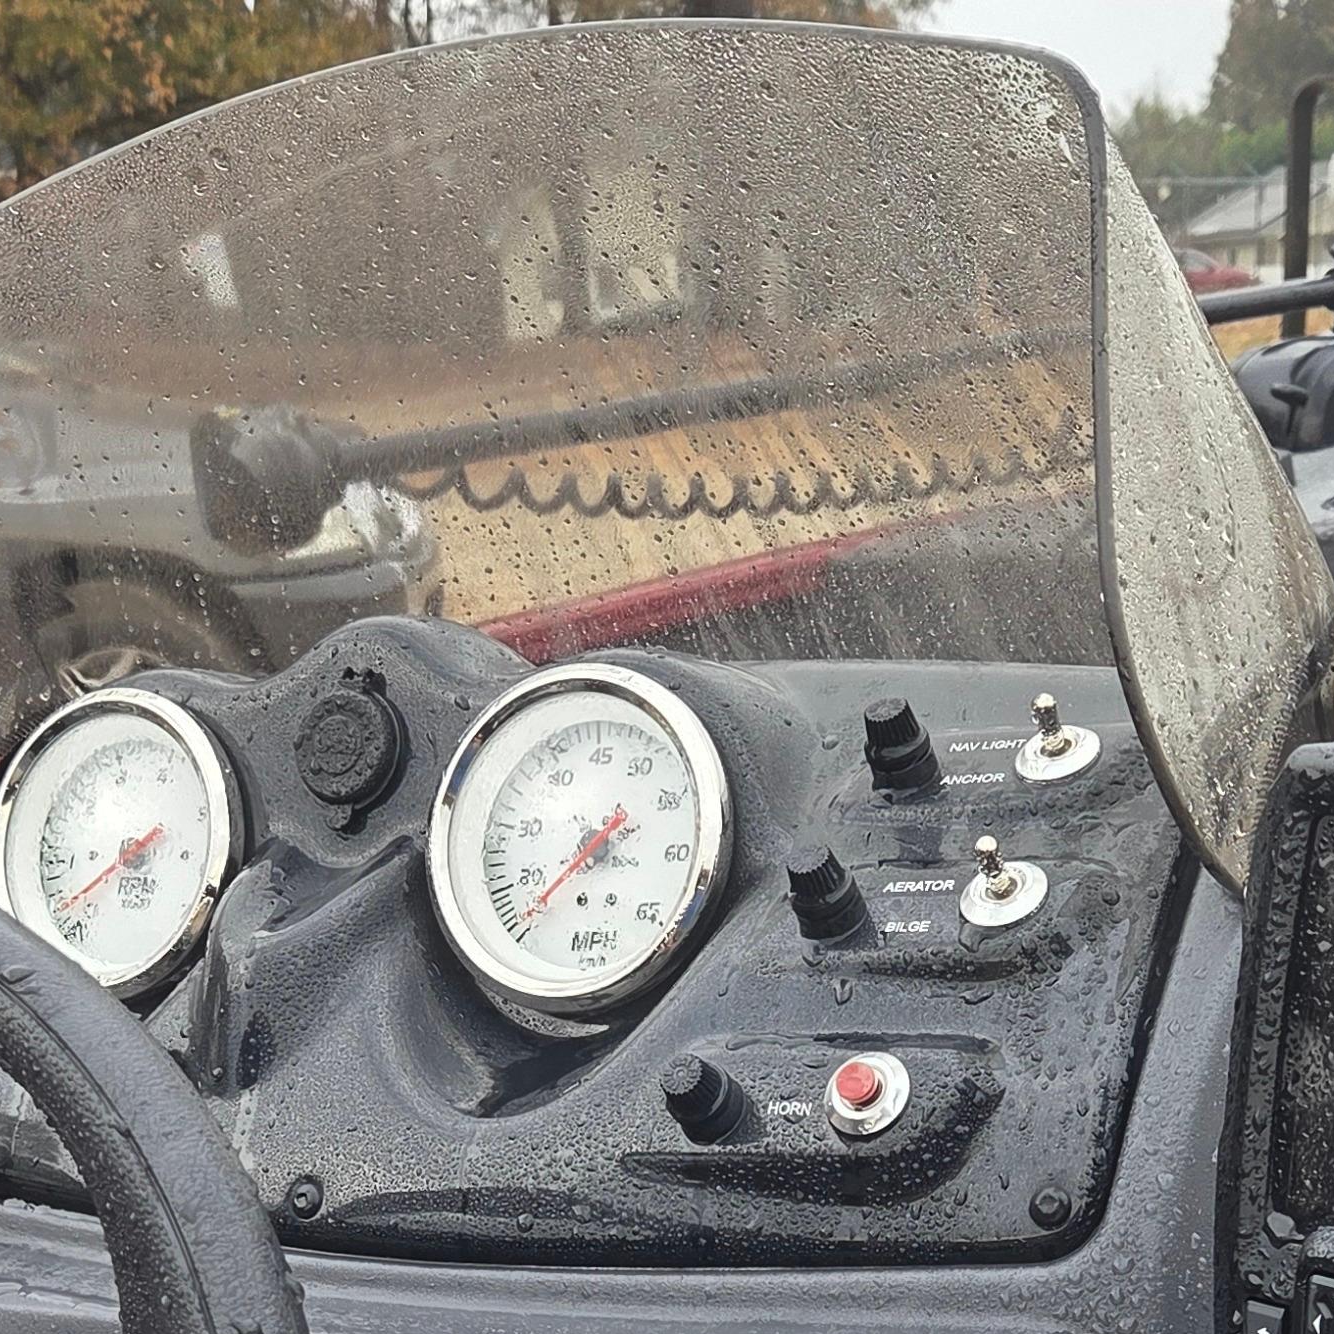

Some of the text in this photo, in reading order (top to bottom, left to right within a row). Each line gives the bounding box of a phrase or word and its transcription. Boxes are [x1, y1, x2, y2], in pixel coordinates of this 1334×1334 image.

[949, 742, 980, 753] NAV
[588, 747, 613, 765] 45
[939, 772, 1005, 786] ANCHOR
[517, 818, 542, 838] 30
[664, 844, 690, 862] 60
[882, 879, 956, 893] AERATOR
[884, 920, 932, 933] BILGE
[571, 930, 618, 952] MPH
[767, 1100, 813, 1116] HORN
